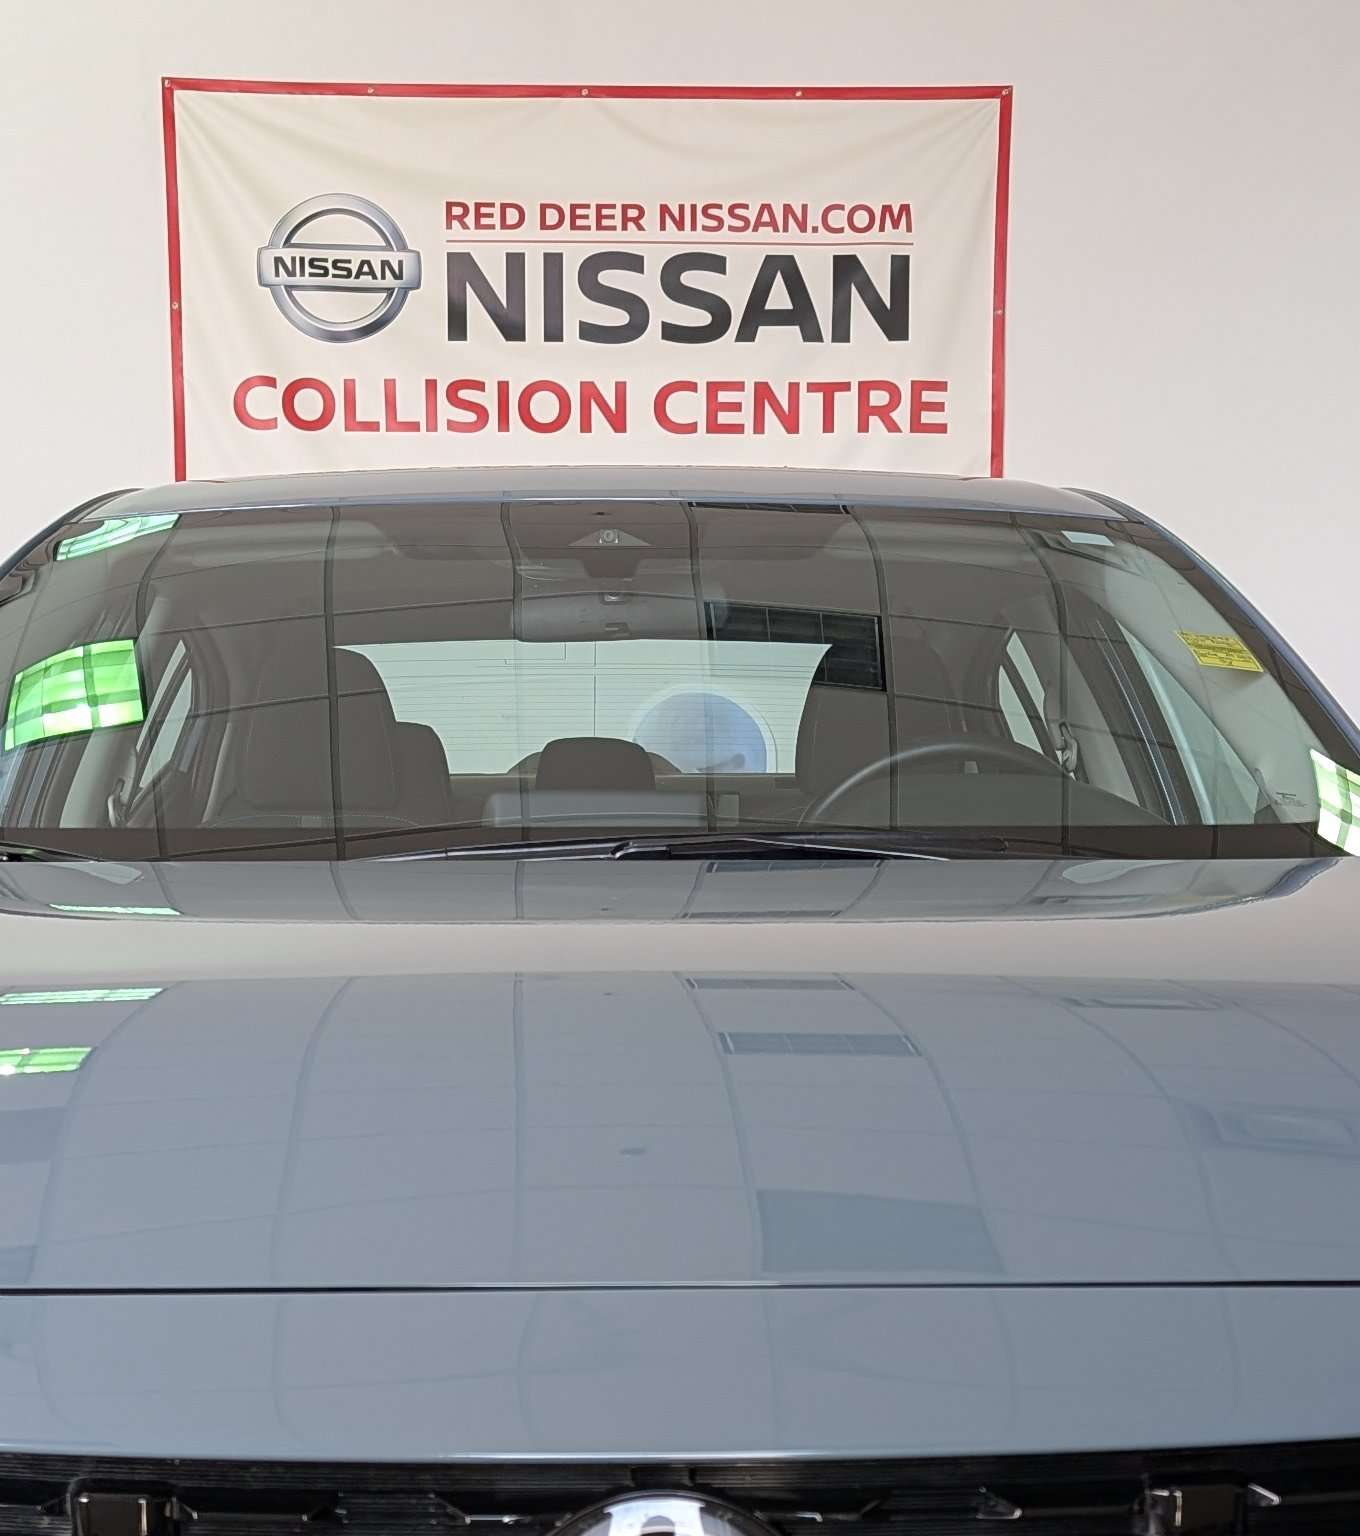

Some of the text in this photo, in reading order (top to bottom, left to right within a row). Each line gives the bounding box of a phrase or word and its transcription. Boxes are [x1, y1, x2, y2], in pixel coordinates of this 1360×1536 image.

[444, 200, 913, 234] RED DEER NISSAN.COM
[273, 256, 404, 281] NISSAN
[446, 251, 911, 343] NISSAN
[233, 375, 949, 435] COLLISION CENTRE
